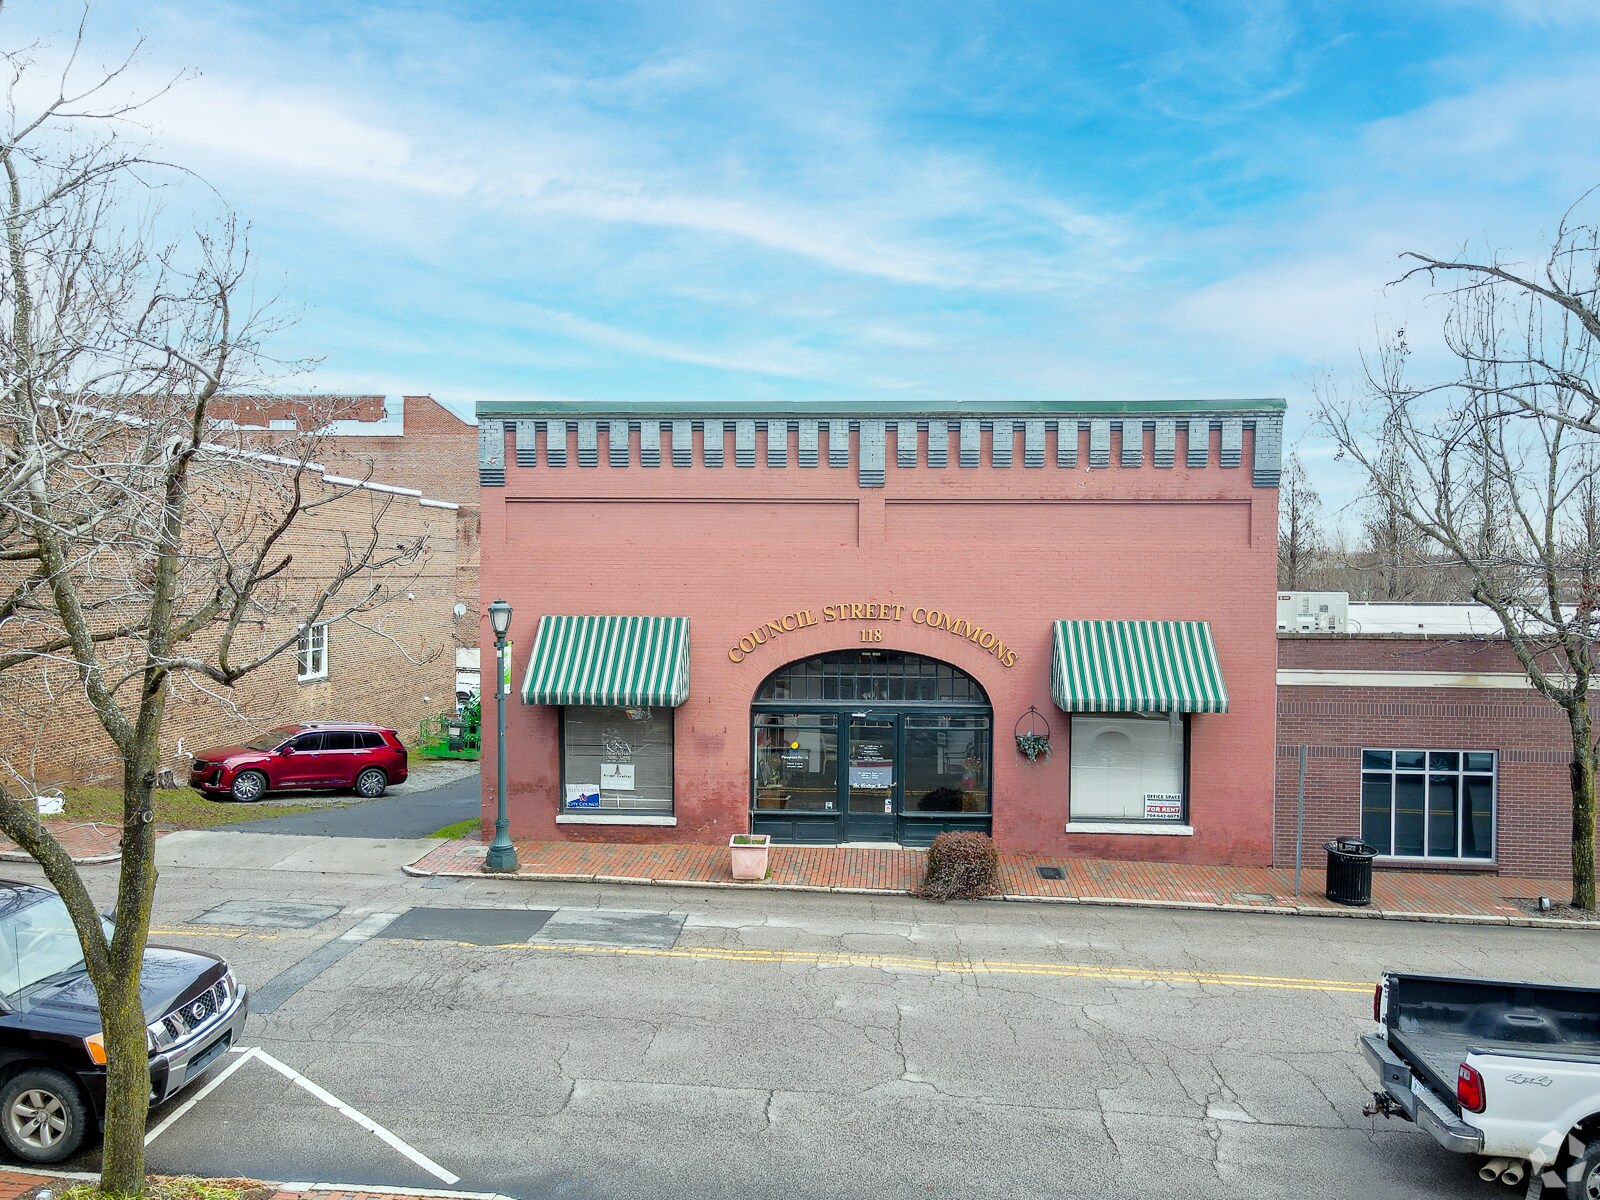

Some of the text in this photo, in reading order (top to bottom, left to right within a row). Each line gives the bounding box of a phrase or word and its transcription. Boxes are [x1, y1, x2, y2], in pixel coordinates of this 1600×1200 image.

[728, 603, 1019, 668] COUNCIL STREET COMMONS
[860, 629, 883, 643] 118
[1505, 1073, 1553, 1087] 4x4
